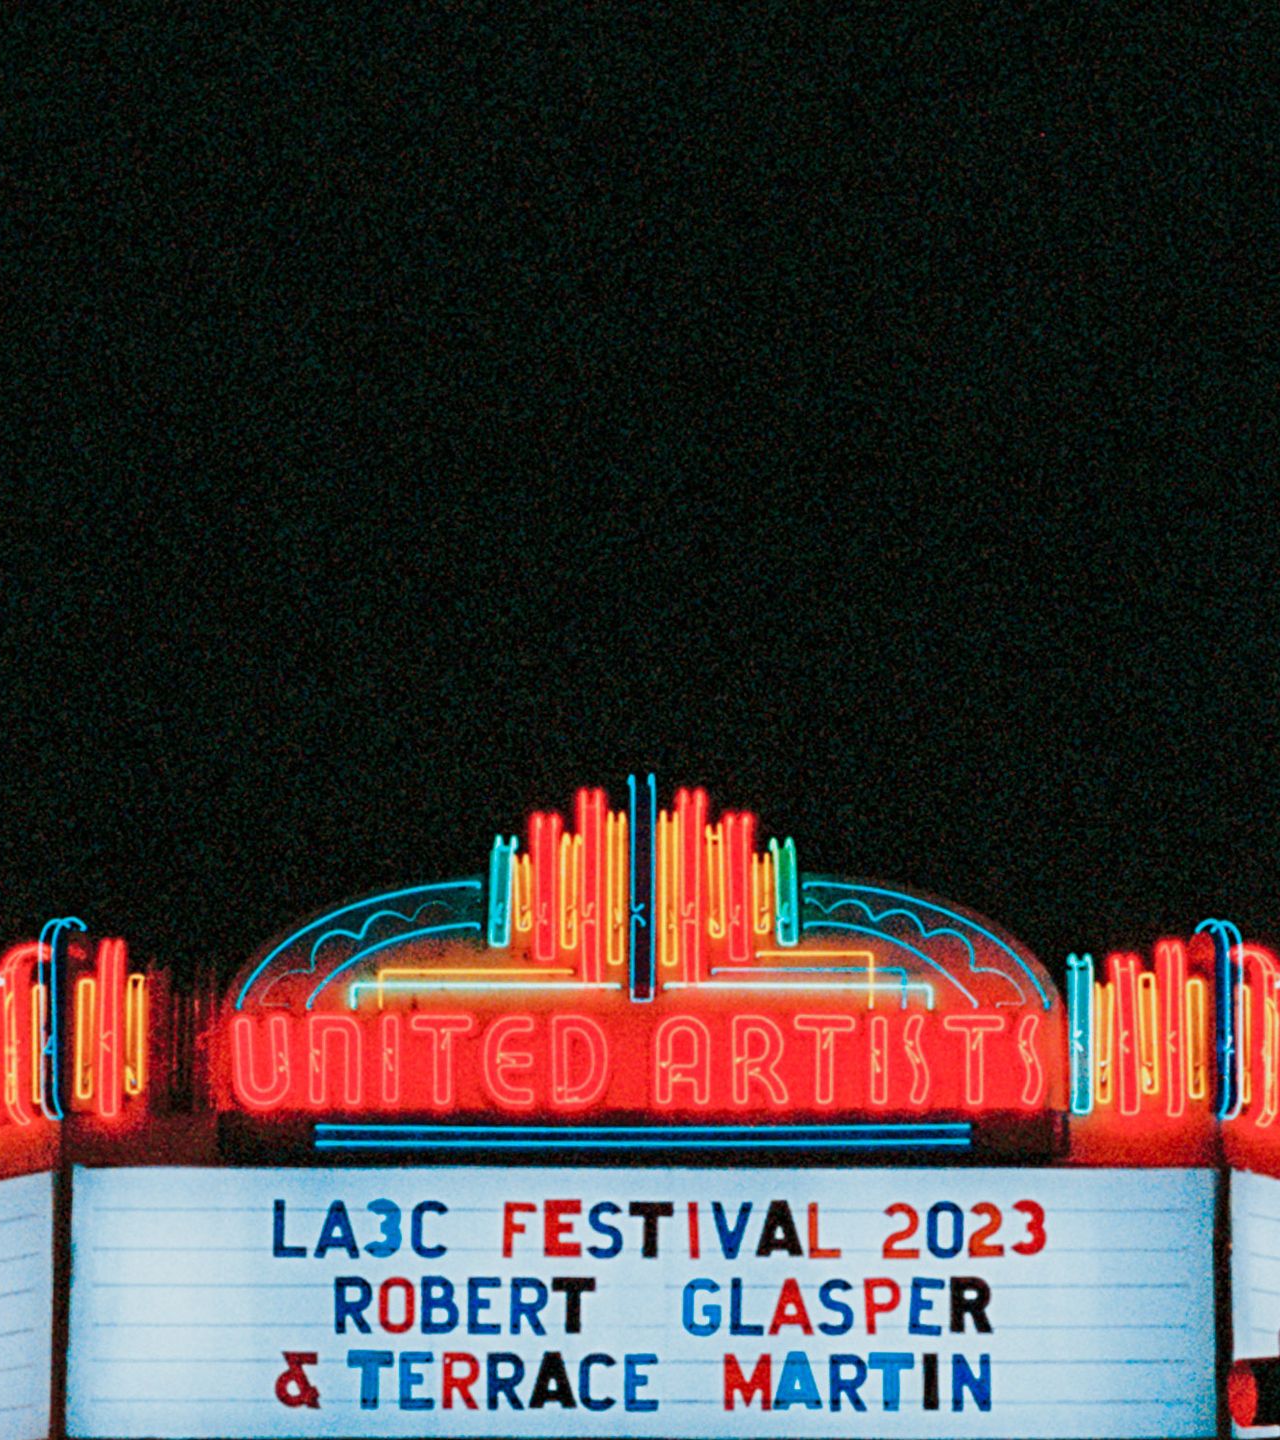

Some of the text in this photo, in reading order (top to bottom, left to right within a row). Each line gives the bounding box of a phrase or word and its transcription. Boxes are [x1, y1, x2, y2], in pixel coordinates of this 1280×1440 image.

[231, 1012, 1044, 1107] UNITED ARTISTS
[272, 1199, 1047, 1259] LA3C FESTIVAL 2023
[333, 1276, 994, 1336] ROBERT GLASPER
[274, 1351, 992, 1412] & TERRACE MARTIN
